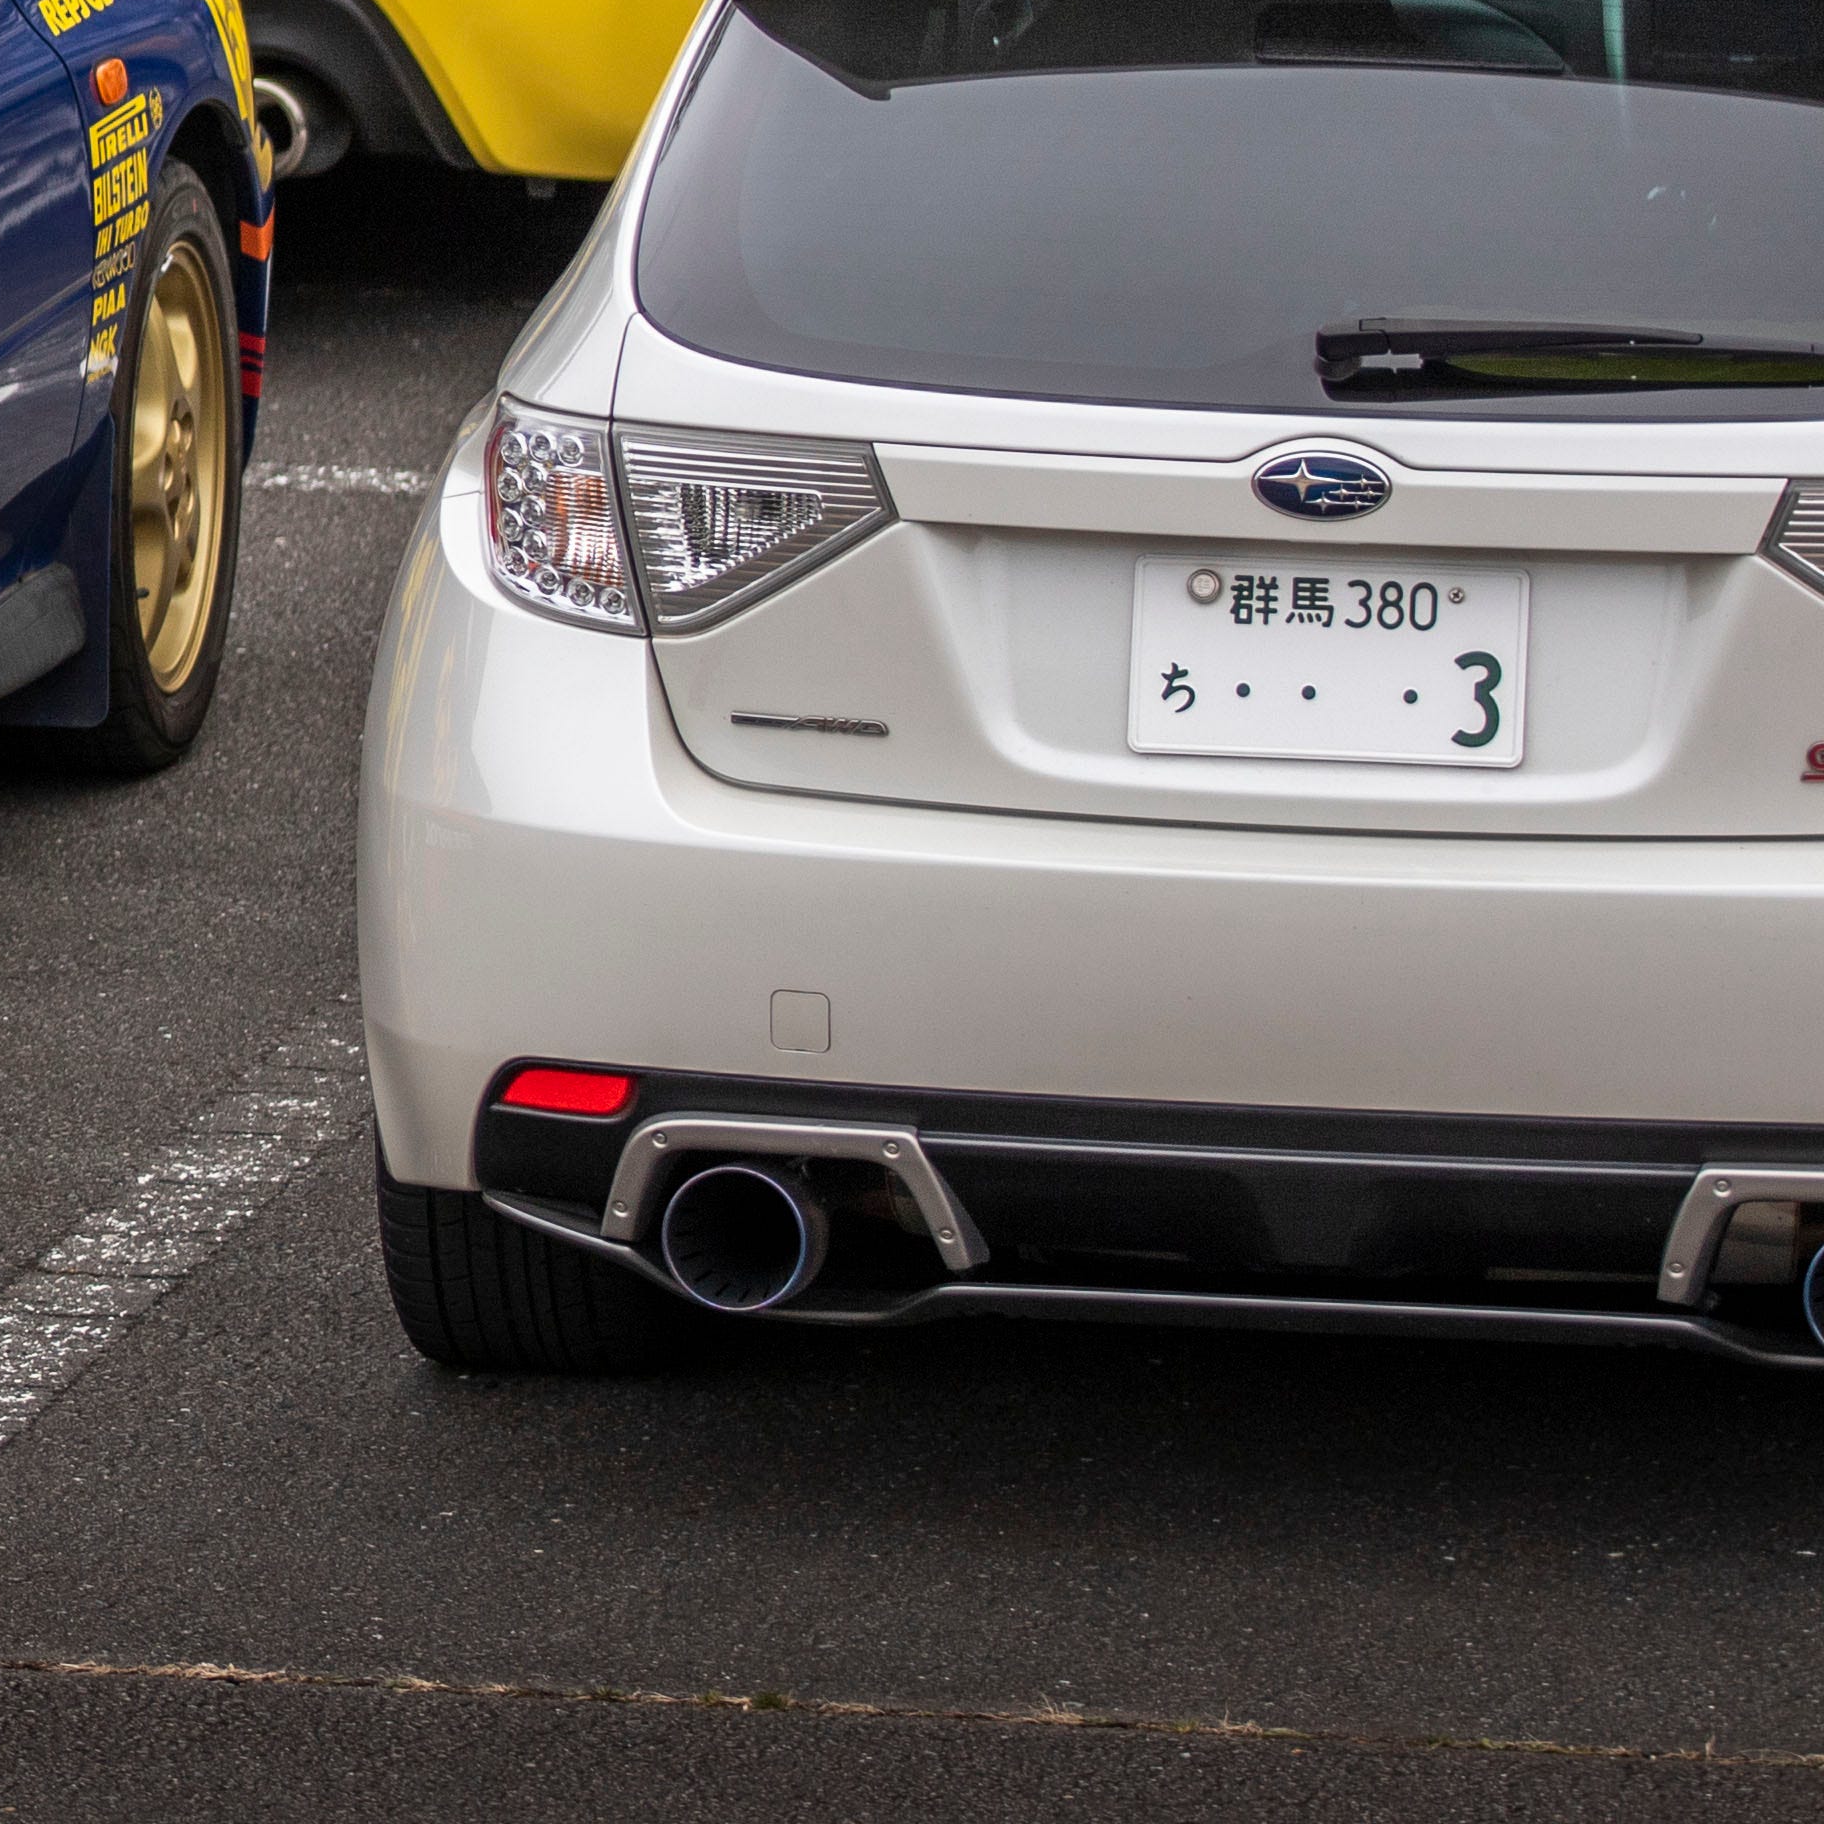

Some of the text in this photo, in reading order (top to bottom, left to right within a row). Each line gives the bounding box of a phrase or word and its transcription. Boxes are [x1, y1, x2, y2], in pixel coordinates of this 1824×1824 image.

[89, 92, 149, 171] PIRELLI
[93, 146, 149, 226] BILSTEIN
[113, 199, 150, 249] TURBO
[92, 282, 126, 327] PIAA
[90, 322, 119, 359] NGK
[1160, 661, 1197, 714] ち
